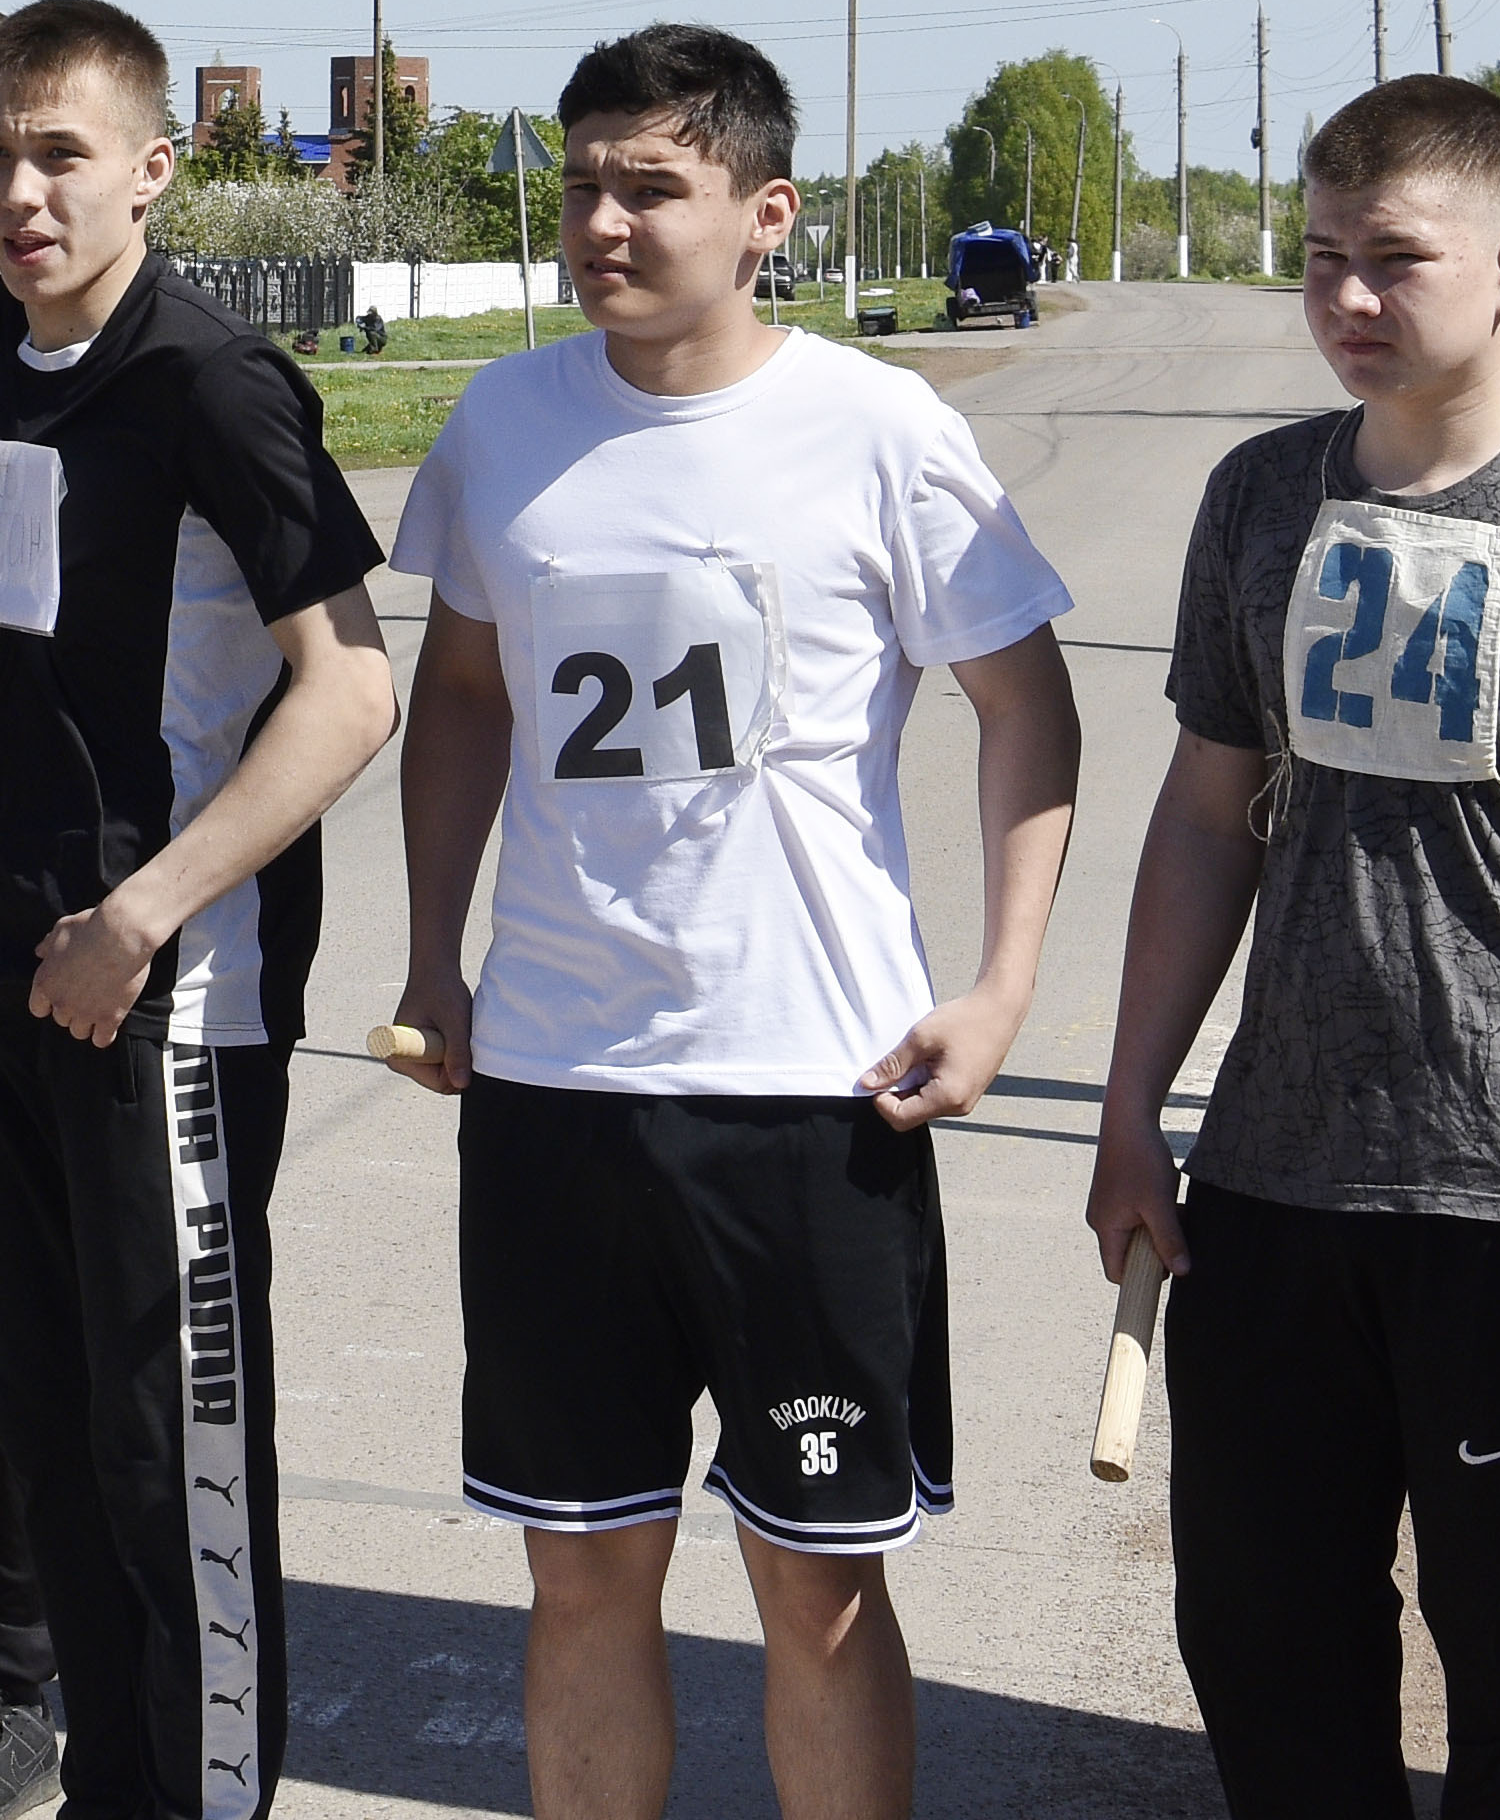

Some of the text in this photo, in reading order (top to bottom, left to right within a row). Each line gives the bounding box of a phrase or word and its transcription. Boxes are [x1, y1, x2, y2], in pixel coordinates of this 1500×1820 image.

[551, 642, 736, 780] 21
[1301, 542, 1490, 743] 24
[185, 1201, 238, 1426] PUMA
[768, 1395, 867, 1431] BROOKLYN
[800, 1431, 838, 1476] 35
